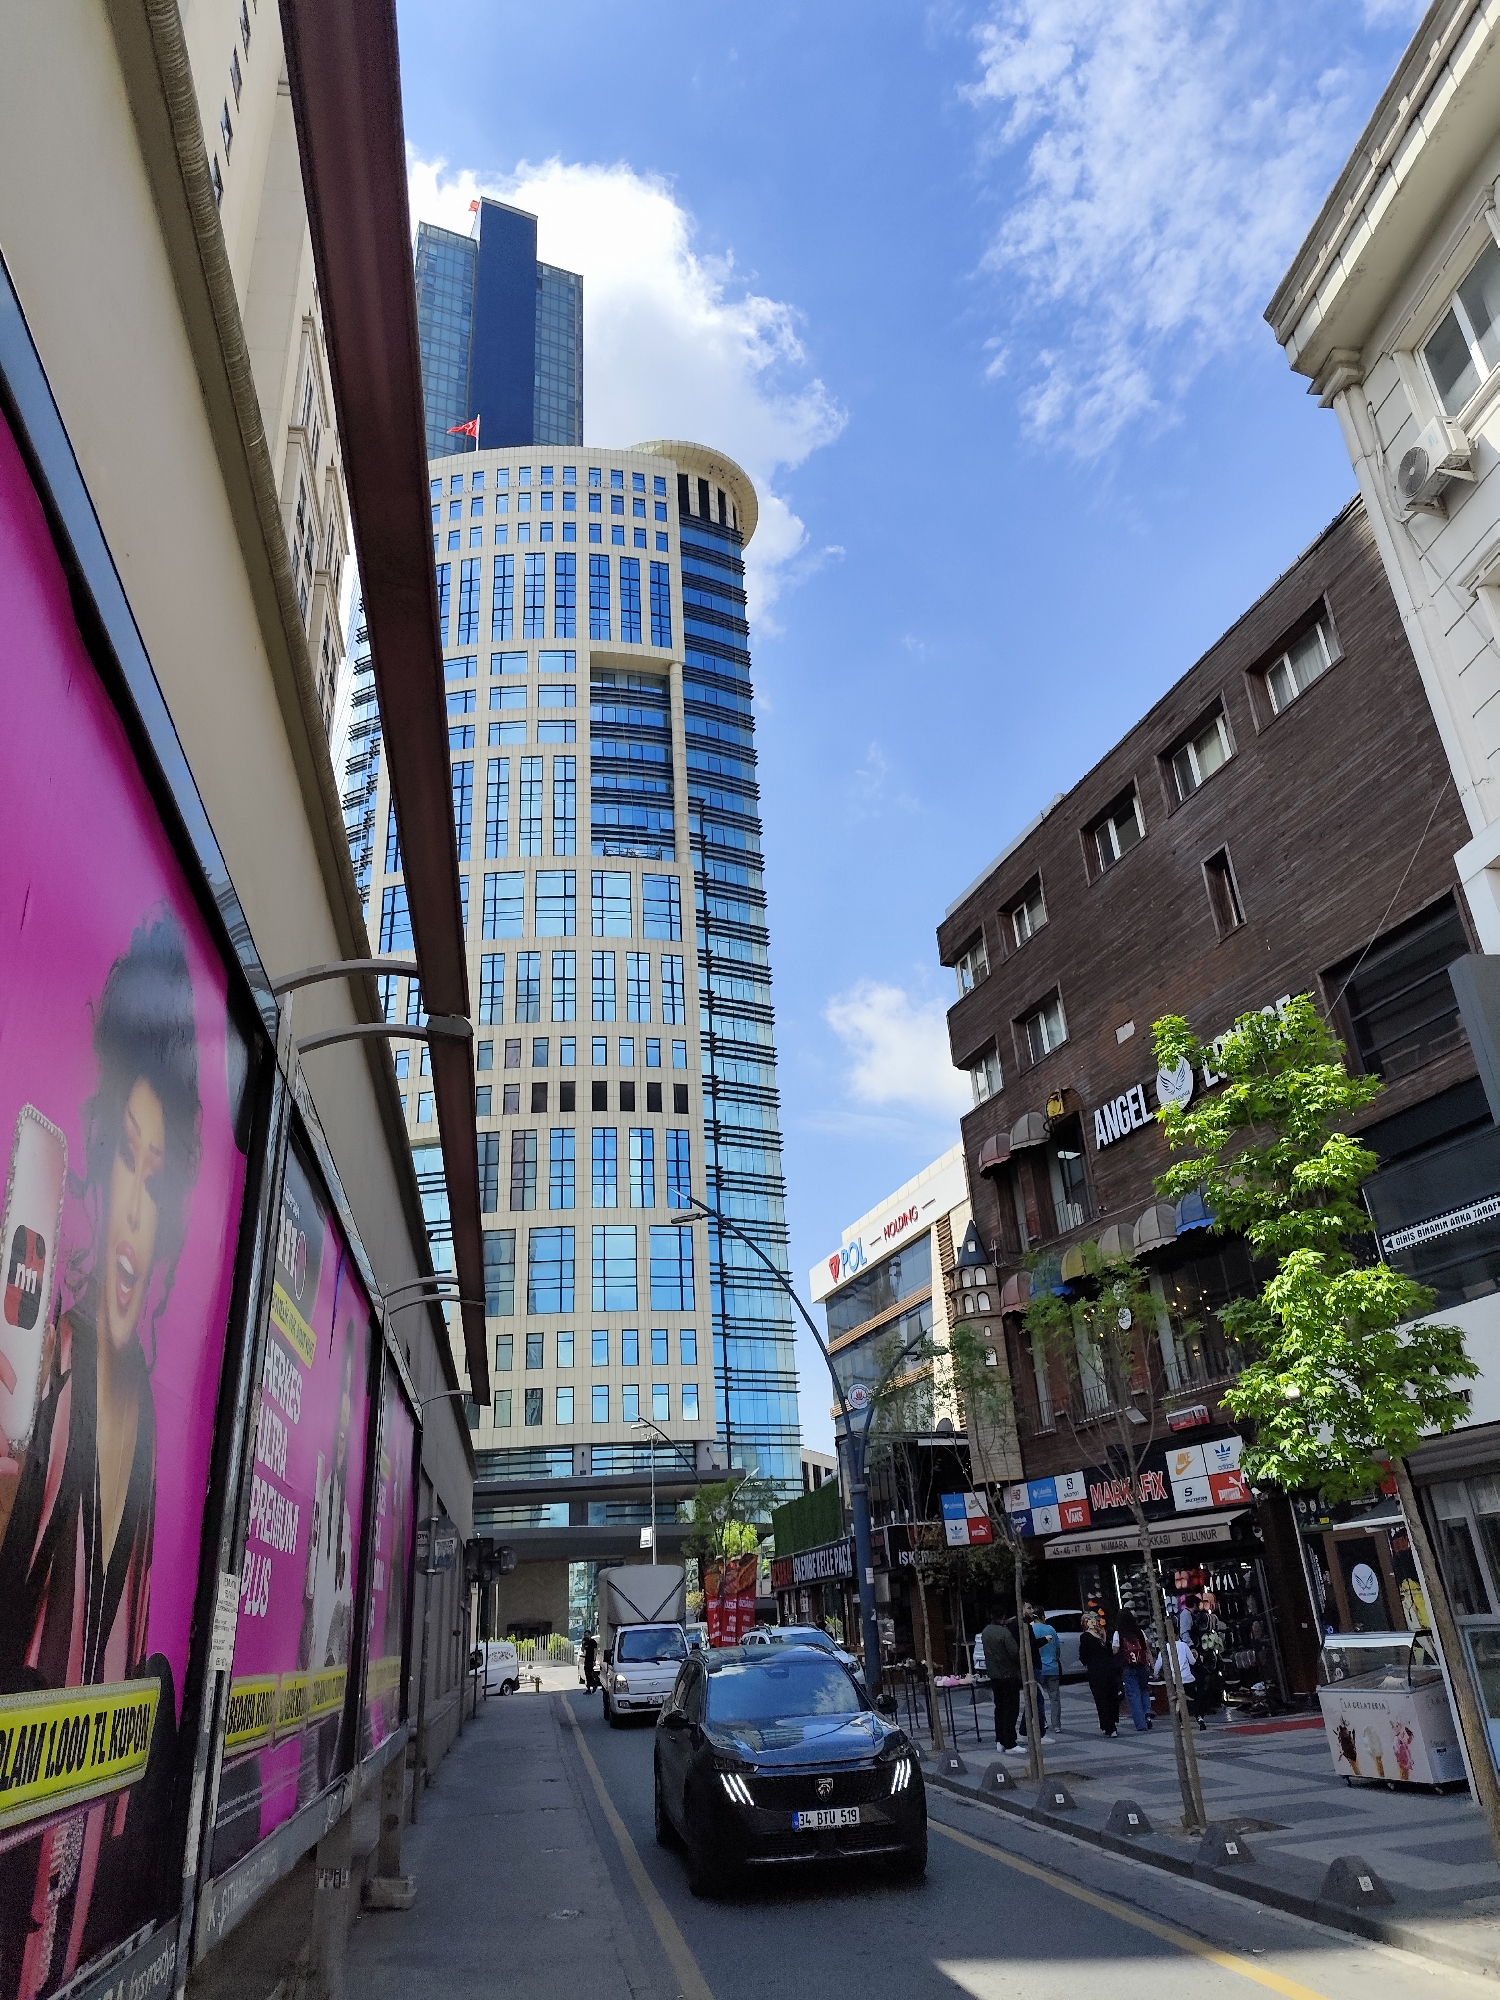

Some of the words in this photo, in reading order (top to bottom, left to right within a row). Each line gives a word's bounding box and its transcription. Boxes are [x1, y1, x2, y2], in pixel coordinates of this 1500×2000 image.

[1094, 1083, 1154, 1150] ANGEL
[841, 1236, 868, 1279] POL
[883, 1204, 919, 1242] HOLDING
[1395, 1231, 1416, 1246] GİRİŞ
[1417, 1220, 1449, 1238] BİNANIN
[1450, 1212, 1472, 1227] ARKA
[263, 1334, 302, 1424] HERKES
[256, 1402, 288, 1481] ULTRA
[1217, 1462, 1235, 1471] adidas
[249, 1474, 300, 1555] PREMIUM
[1064, 1506, 1083, 1523] VANS
[1089, 1470, 1168, 1511] MARKFİX
[834, 1543, 852, 1577] PAÇA
[1100, 1540, 1129, 1551] NUMARA
[1137, 1534, 1171, 1548] AKKABI
[1181, 1528, 1218, 1543] BULUNUR
[240, 1550, 272, 1618] PLUS
[44, 1713, 91, 1780] 1.000
[91, 1711, 108, 1767] TL
[107, 1702, 151, 1762] KUPON
[799, 1813, 812, 1827] 34
[816, 1810, 836, 1826] BTU
[840, 1808, 857, 1823] 519
